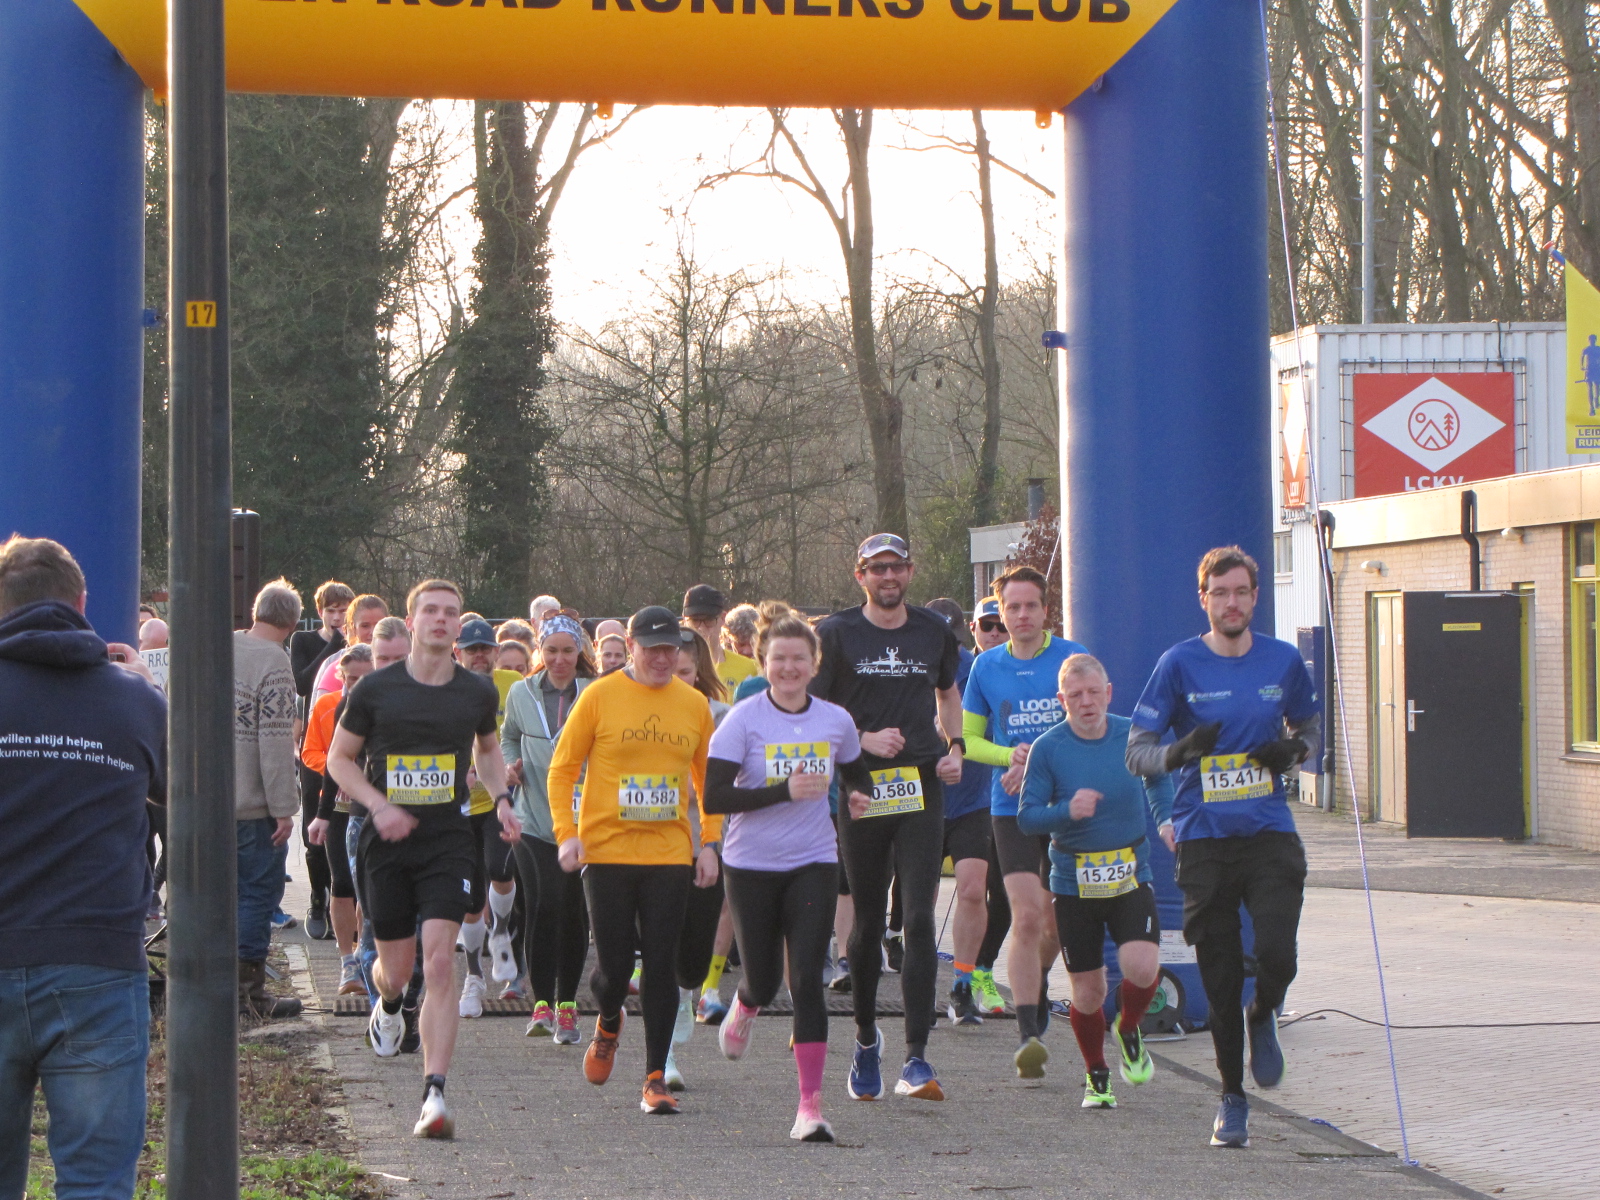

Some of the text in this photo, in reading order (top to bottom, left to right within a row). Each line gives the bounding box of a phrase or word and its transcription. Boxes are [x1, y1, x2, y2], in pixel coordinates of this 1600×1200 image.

[191, 304, 213, 324] 17
[1404, 475, 1464, 491] LCKV
[1019, 698, 1062, 712] LOOP
[1008, 710, 1063, 727] GROEP
[621, 719, 690, 747] parkrun
[34, 734, 64, 748] altijd
[66, 736, 103, 750] helpen
[43, 750, 59, 759] we
[62, 750, 82, 760] ook
[85, 752, 105, 764] niet
[107, 754, 135, 772] helpen
[773, 759, 827, 776] 15255
[394, 772, 450, 788] 10.590
[1208, 766, 1264, 789] 15.417
[626, 790, 676, 805] 10.582
[872, 781, 917, 801] 0.580
[1082, 863, 1132, 883] 15.254
